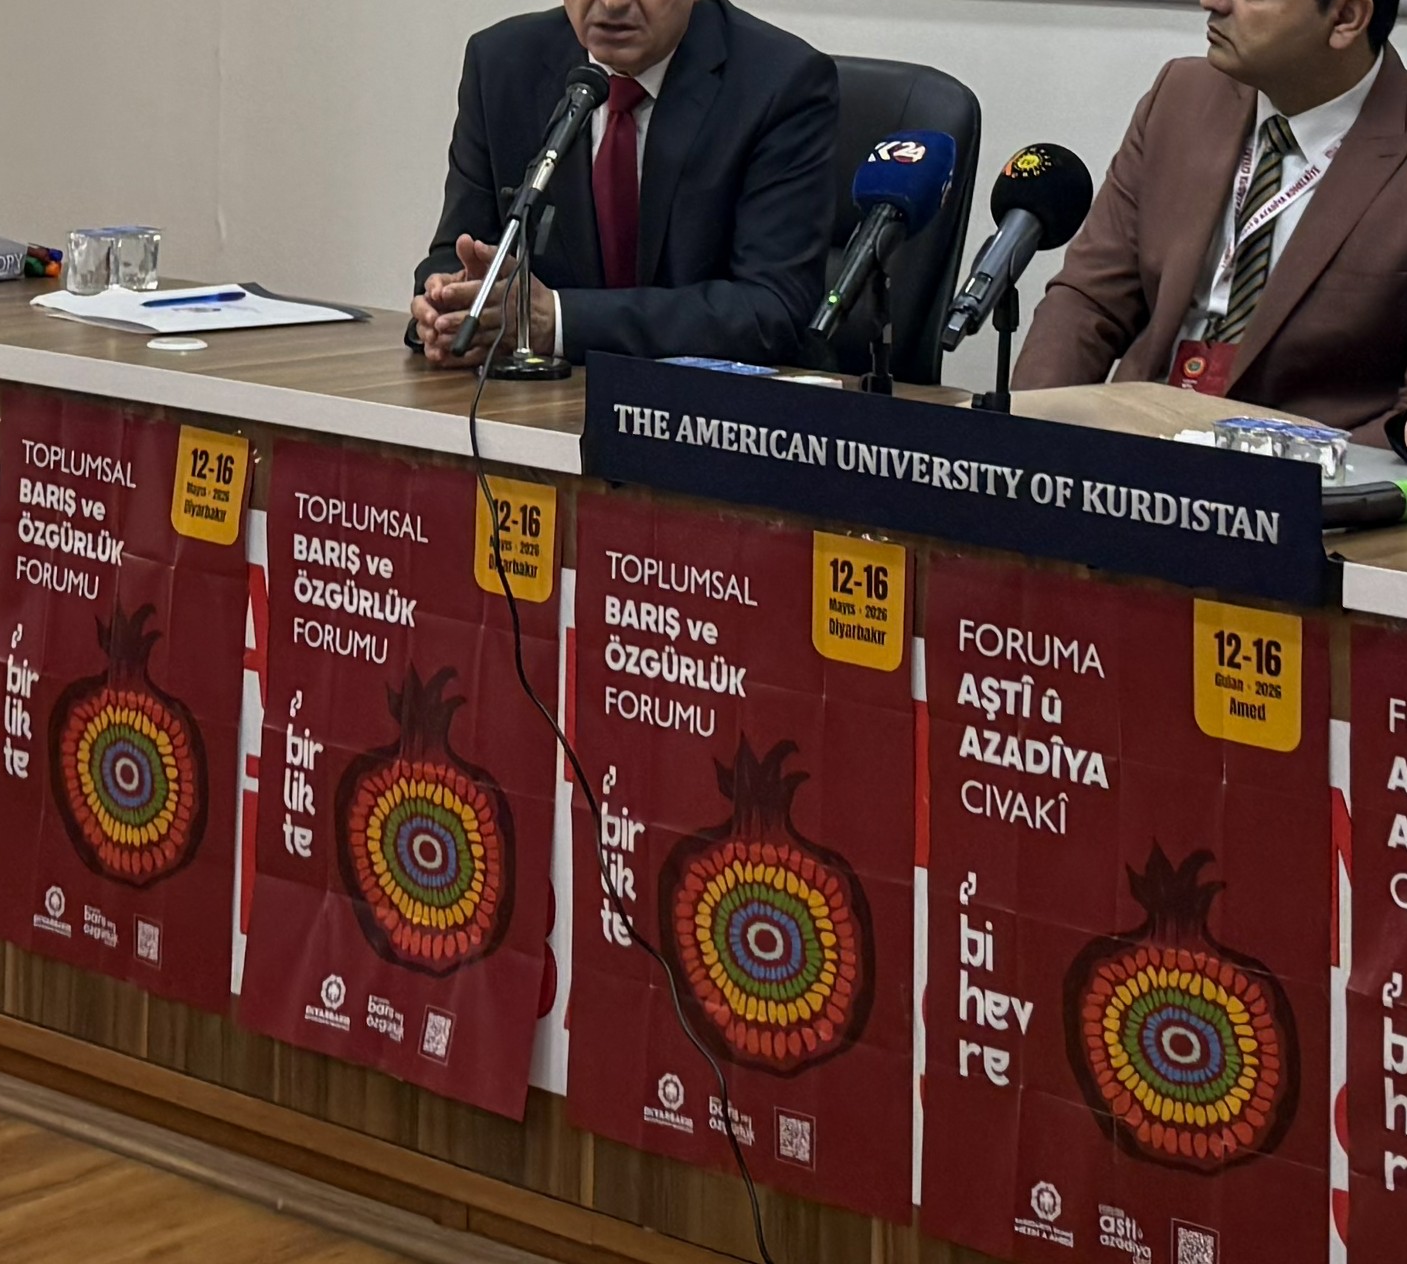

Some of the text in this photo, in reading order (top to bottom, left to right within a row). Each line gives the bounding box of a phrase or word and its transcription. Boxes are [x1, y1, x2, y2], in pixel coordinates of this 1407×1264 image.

[22, 439, 136, 488] TOPLUMSAL
[191, 448, 234, 485] 12-16
[614, 404, 1280, 545] THE AMERICAN UNIVERSITY OF KURDISTAN
[20, 478, 106, 520] BARIŞ ve
[295, 492, 428, 544] TOPLUMSAL
[18, 512, 124, 566] ÖZGÜRLÜK
[294, 534, 393, 579] BARIŞ ve
[16, 556, 99, 599] FORUMU
[294, 571, 417, 628] ÖZGÜRLÜK
[605, 550, 758, 606] TOPLUMSAL
[830, 558, 888, 600] 12-16
[294, 617, 388, 664] FORUMU
[605, 596, 718, 645] BARIŞ ve
[605, 635, 747, 697] ÖZGÜRLÜK
[959, 619, 1105, 679] FORUMA
[1214, 629, 1282, 677] 12-16
[7, 654, 39, 698] bir
[957, 672, 1062, 723] AŞTÎ û
[1255, 681, 1282, 699] 2026
[5, 696, 32, 740] lik
[605, 686, 715, 737] FORUMU
[1229, 697, 1266, 721] Amed
[4, 737, 29, 778] te
[286, 723, 323, 770] bir
[959, 726, 1109, 789] AZADÎYA
[284, 768, 315, 816] lik
[960, 779, 1069, 835] CIVAKÎ
[283, 813, 313, 857] te
[600, 802, 645, 852] bir
[601, 901, 632, 947] te
[960, 913, 994, 971] bi
[959, 970, 1034, 1035] hev
[959, 1039, 1010, 1086] re
